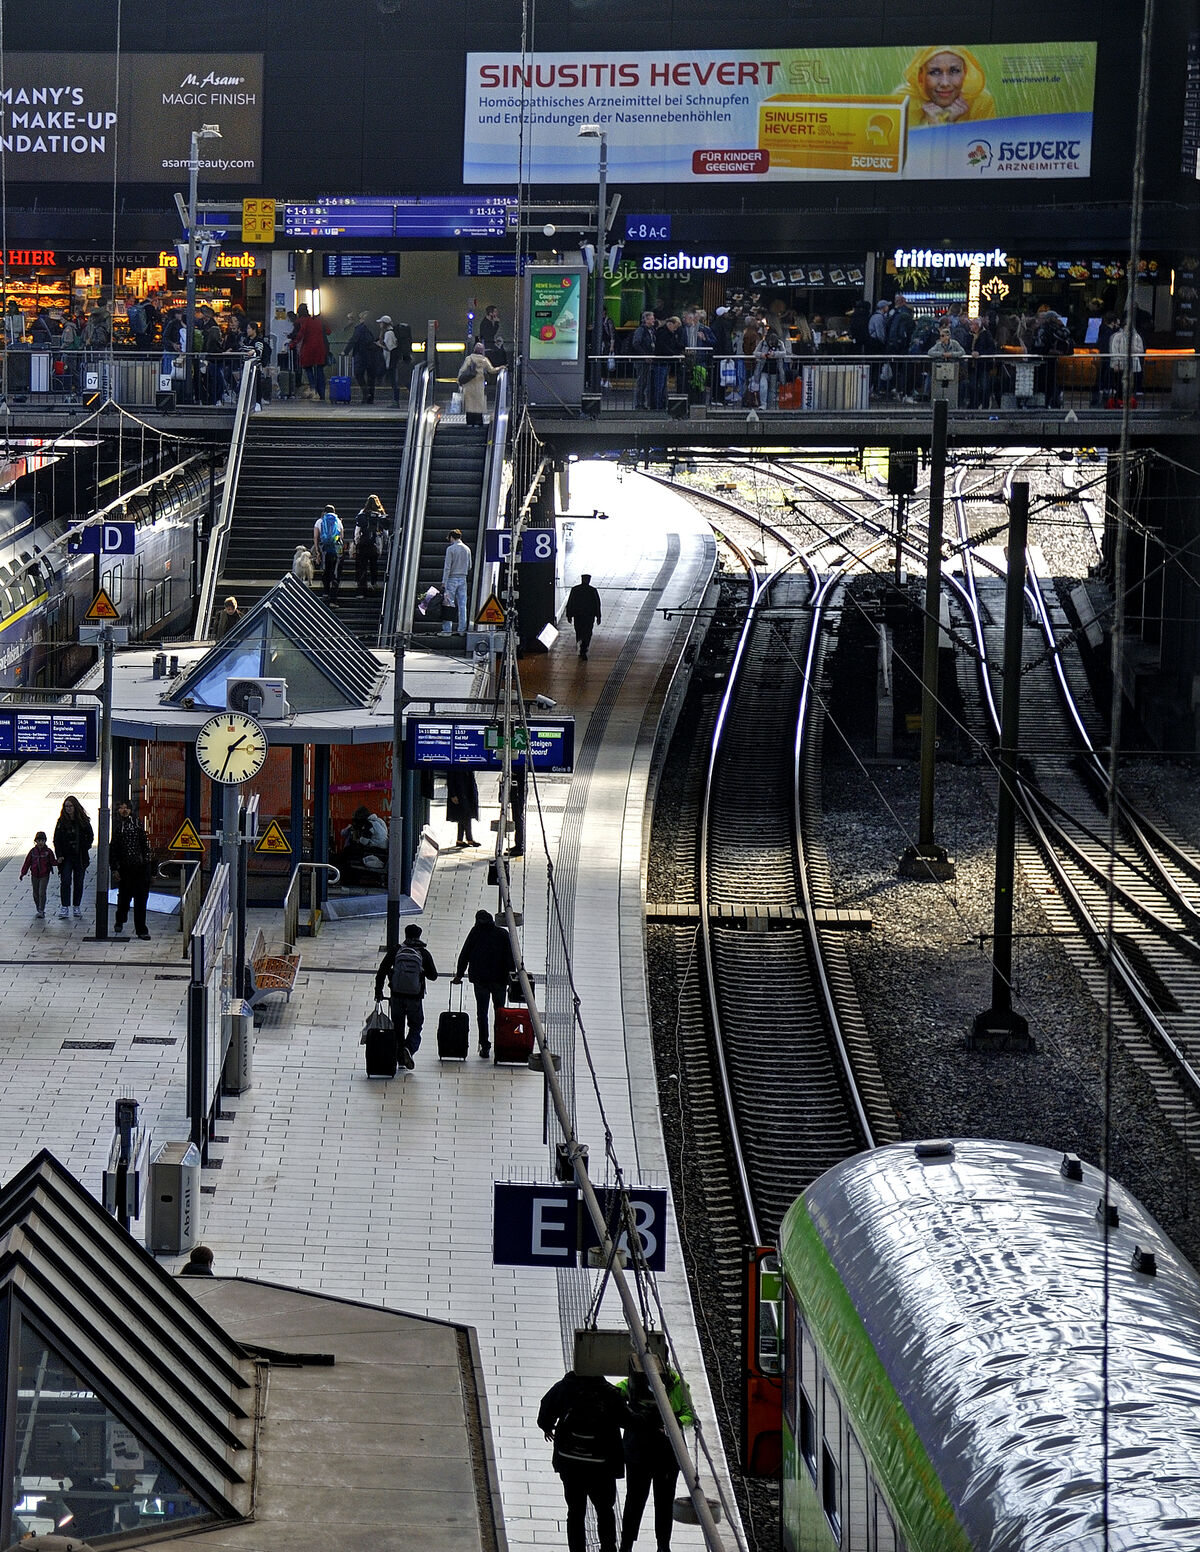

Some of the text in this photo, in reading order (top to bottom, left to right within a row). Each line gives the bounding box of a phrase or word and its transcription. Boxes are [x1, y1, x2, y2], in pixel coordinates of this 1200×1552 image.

[479, 64, 640, 88] SINUSITIS
[650, 61, 781, 87] HEVERT
[1001, 75, 1061, 84] www.hevert.de
[162, 93, 256, 105] MAGIC FINISH
[479, 93, 750, 110] Homöopathisches Arzneimittel bei Schnupfen
[12, 111, 117, 130] MAKE-UP
[478, 110, 732, 126] und Entzündungen der Nasennebenhöhlen
[765, 111, 828, 123] SINUSITIS
[700, 151, 762, 162] FÜR KINDER
[997, 140, 1081, 161] HEVERT
[162, 158, 255, 170] asameauty.com
[705, 162, 756, 172] GEEIGNET
[997, 161, 1080, 172] ARZNEIMITTEL
[294, 207, 308, 216] 1-6
[476, 207, 497, 216] 11-14
[639, 224, 667, 238] 8 A-C
[8, 250, 57, 266] HIER
[215, 251, 256, 268] riends
[642, 251, 730, 273] asiahung
[894, 248, 1008, 268] frittenwerk
[87, 376, 98, 385] o7
[161, 378, 171, 387] s7
[805, 381, 813, 408] Abfall
[104, 526, 123, 551] D
[534, 533, 552, 558] 8
[531, 1197, 658, 1260] E 8
